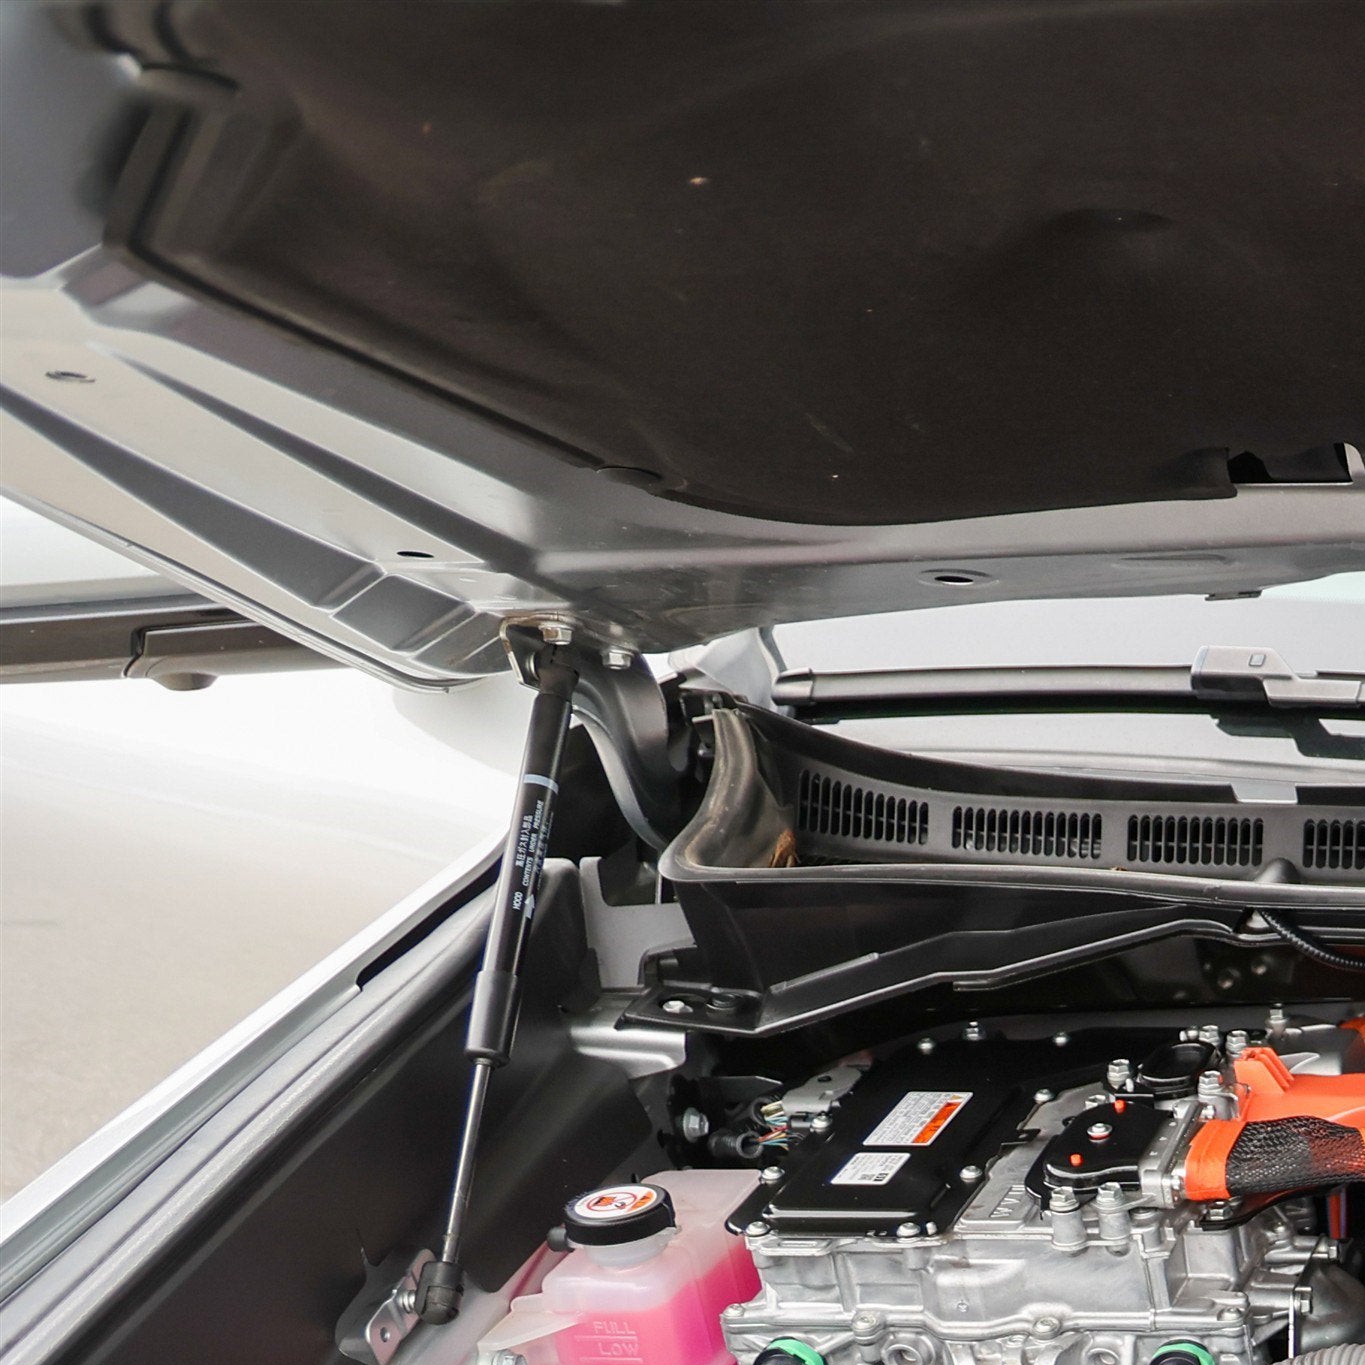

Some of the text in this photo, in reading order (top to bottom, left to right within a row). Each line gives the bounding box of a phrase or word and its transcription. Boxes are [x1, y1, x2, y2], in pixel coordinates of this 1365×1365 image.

[522, 800, 544, 886] CONTENTS UNDER PRESSURE
[513, 891, 523, 910] HOOD
[593, 1321, 636, 1335] FULL
[598, 1342, 639, 1356] LOW
